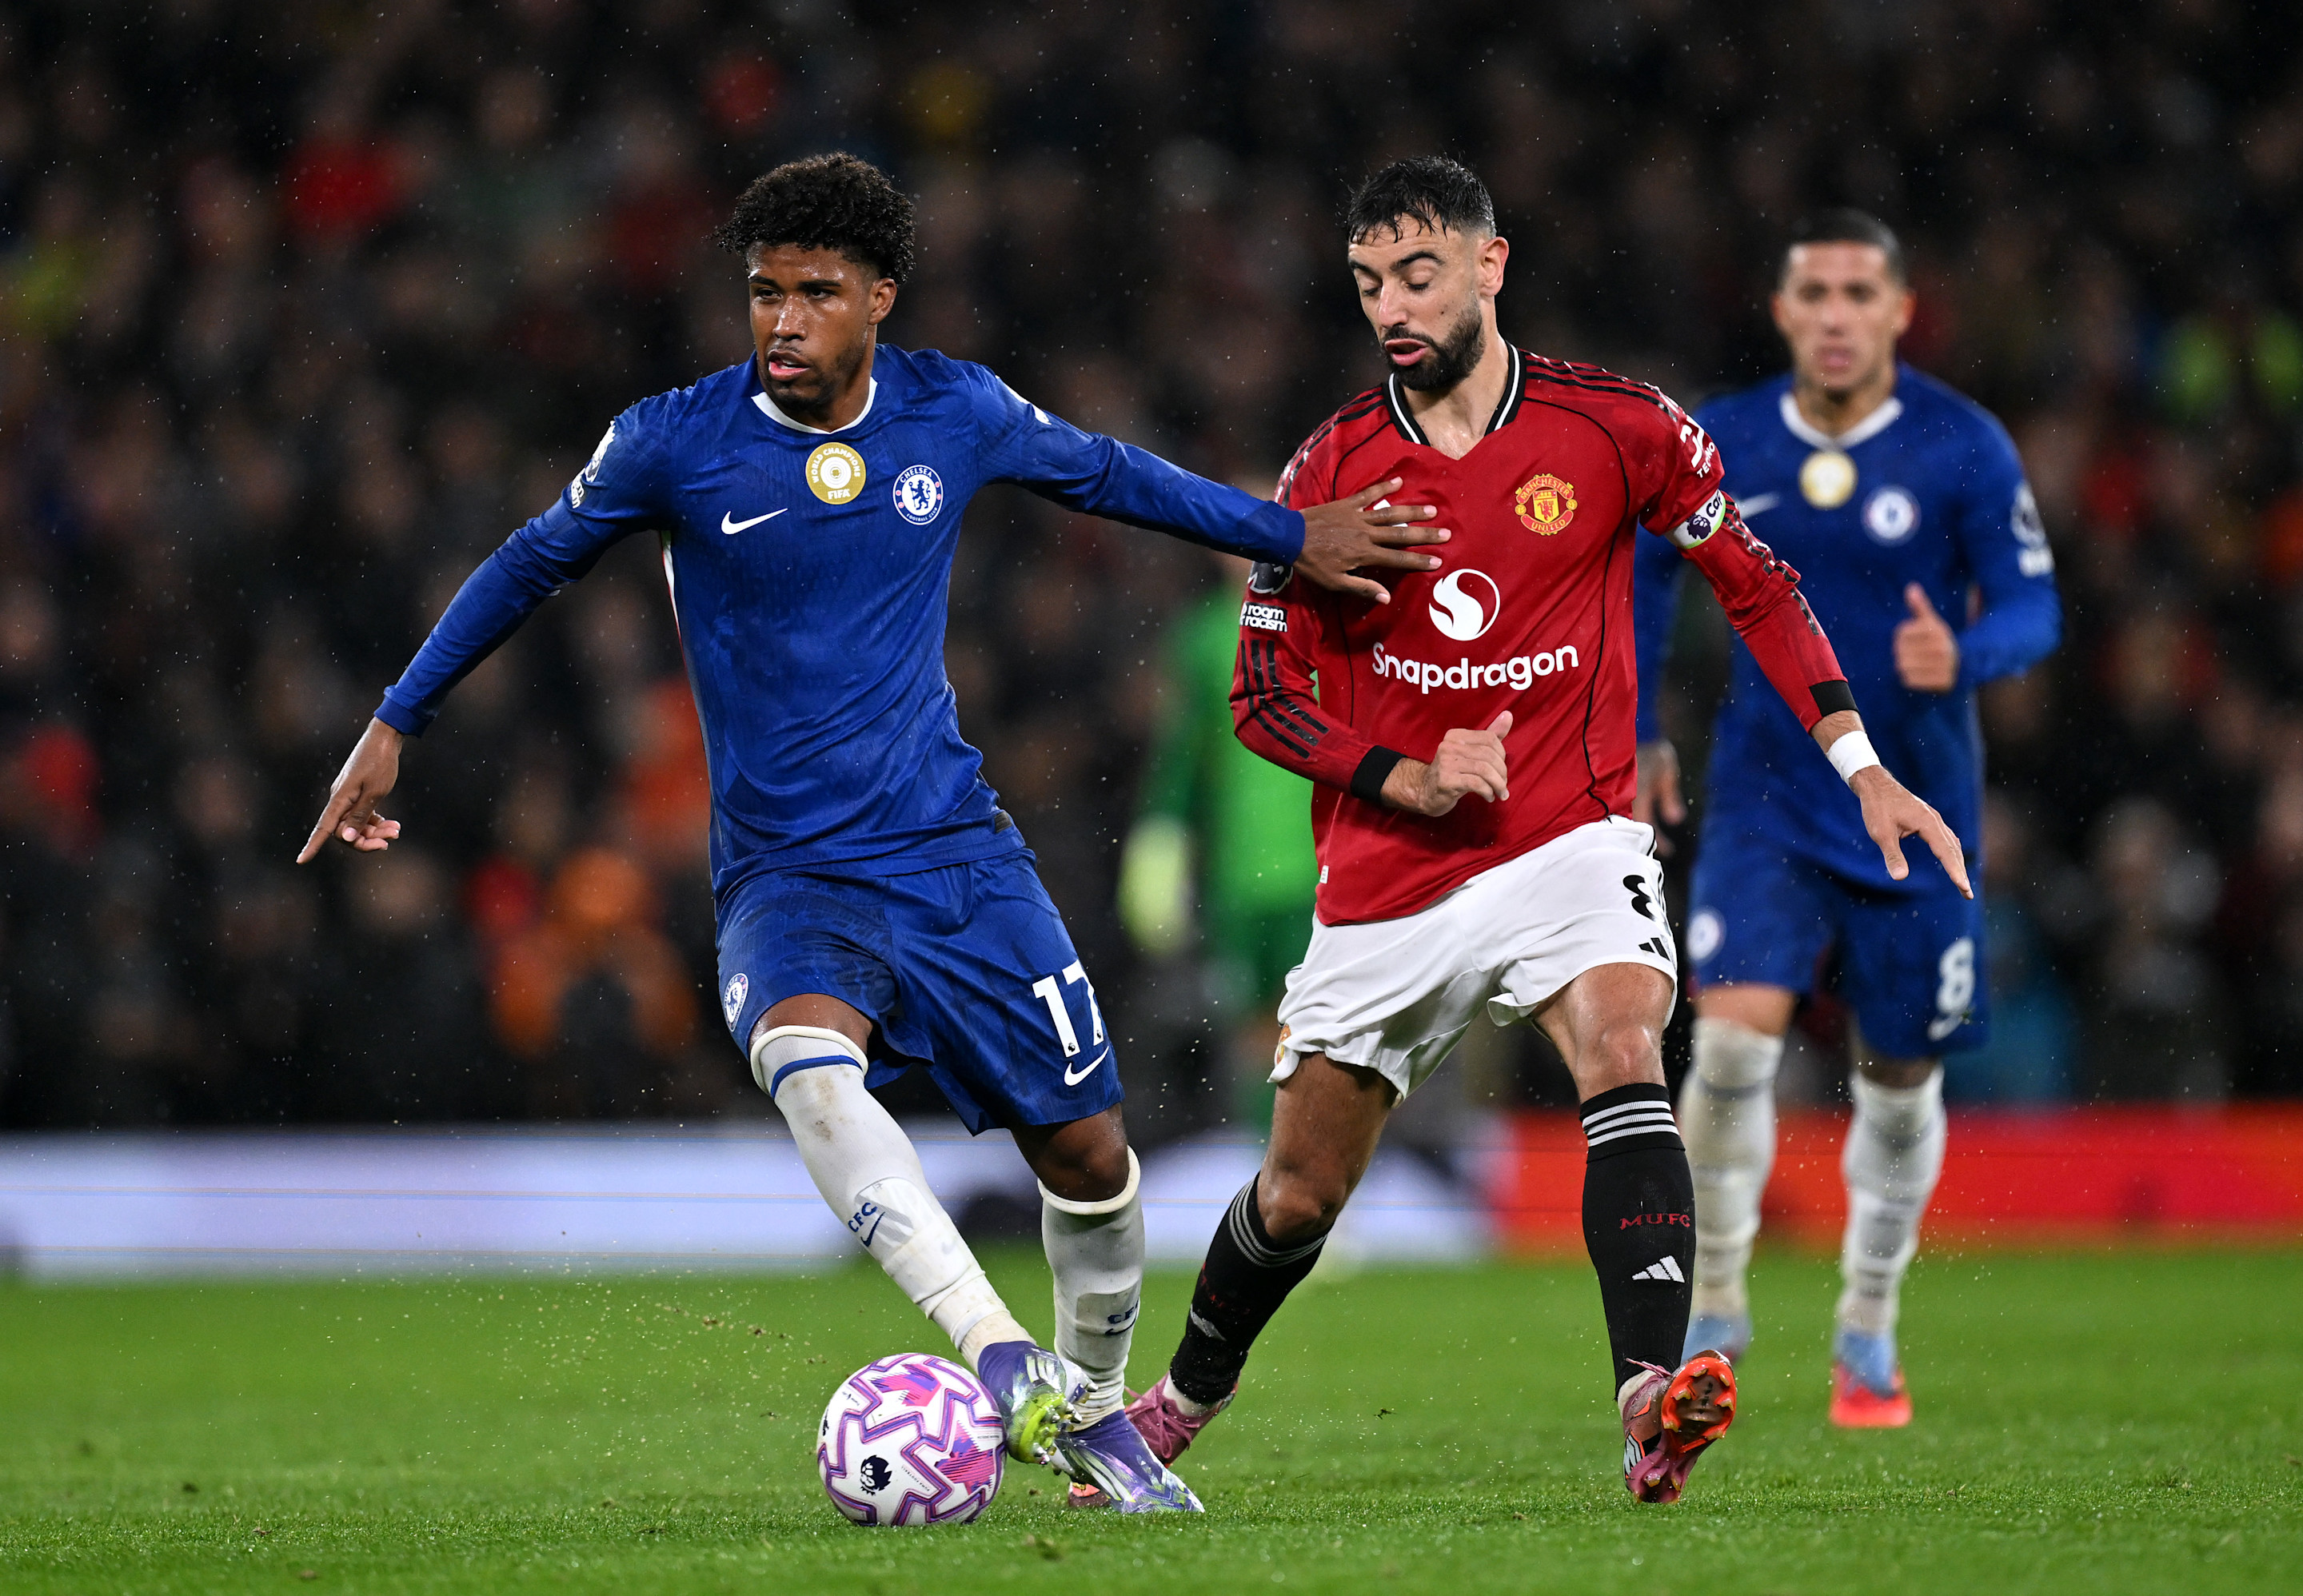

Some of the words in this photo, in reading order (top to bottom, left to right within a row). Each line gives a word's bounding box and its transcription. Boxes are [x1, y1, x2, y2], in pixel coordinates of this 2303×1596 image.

[812, 453, 824, 484] WORLD
[823, 447, 861, 477] CHAMPIONS
[1697, 442, 1715, 478] TECNO
[900, 467, 932, 483] CHELSEA
[827, 488, 852, 500] FIFA
[1520, 478, 1570, 500] MANCHESTER
[906, 513, 928, 522] FOOTBALL
[928, 507, 938, 519] CLUB
[1531, 519, 1566, 531] UNITED
[1247, 604, 1284, 620] room
[1244, 616, 1287, 632] racism
[1371, 642, 1579, 695] Snapdragon
[1937, 938, 1975, 1014] 8
[1032, 959, 1104, 1057] 17
[848, 1202, 877, 1233] CFC
[1619, 1213, 1690, 1230] MUFC
